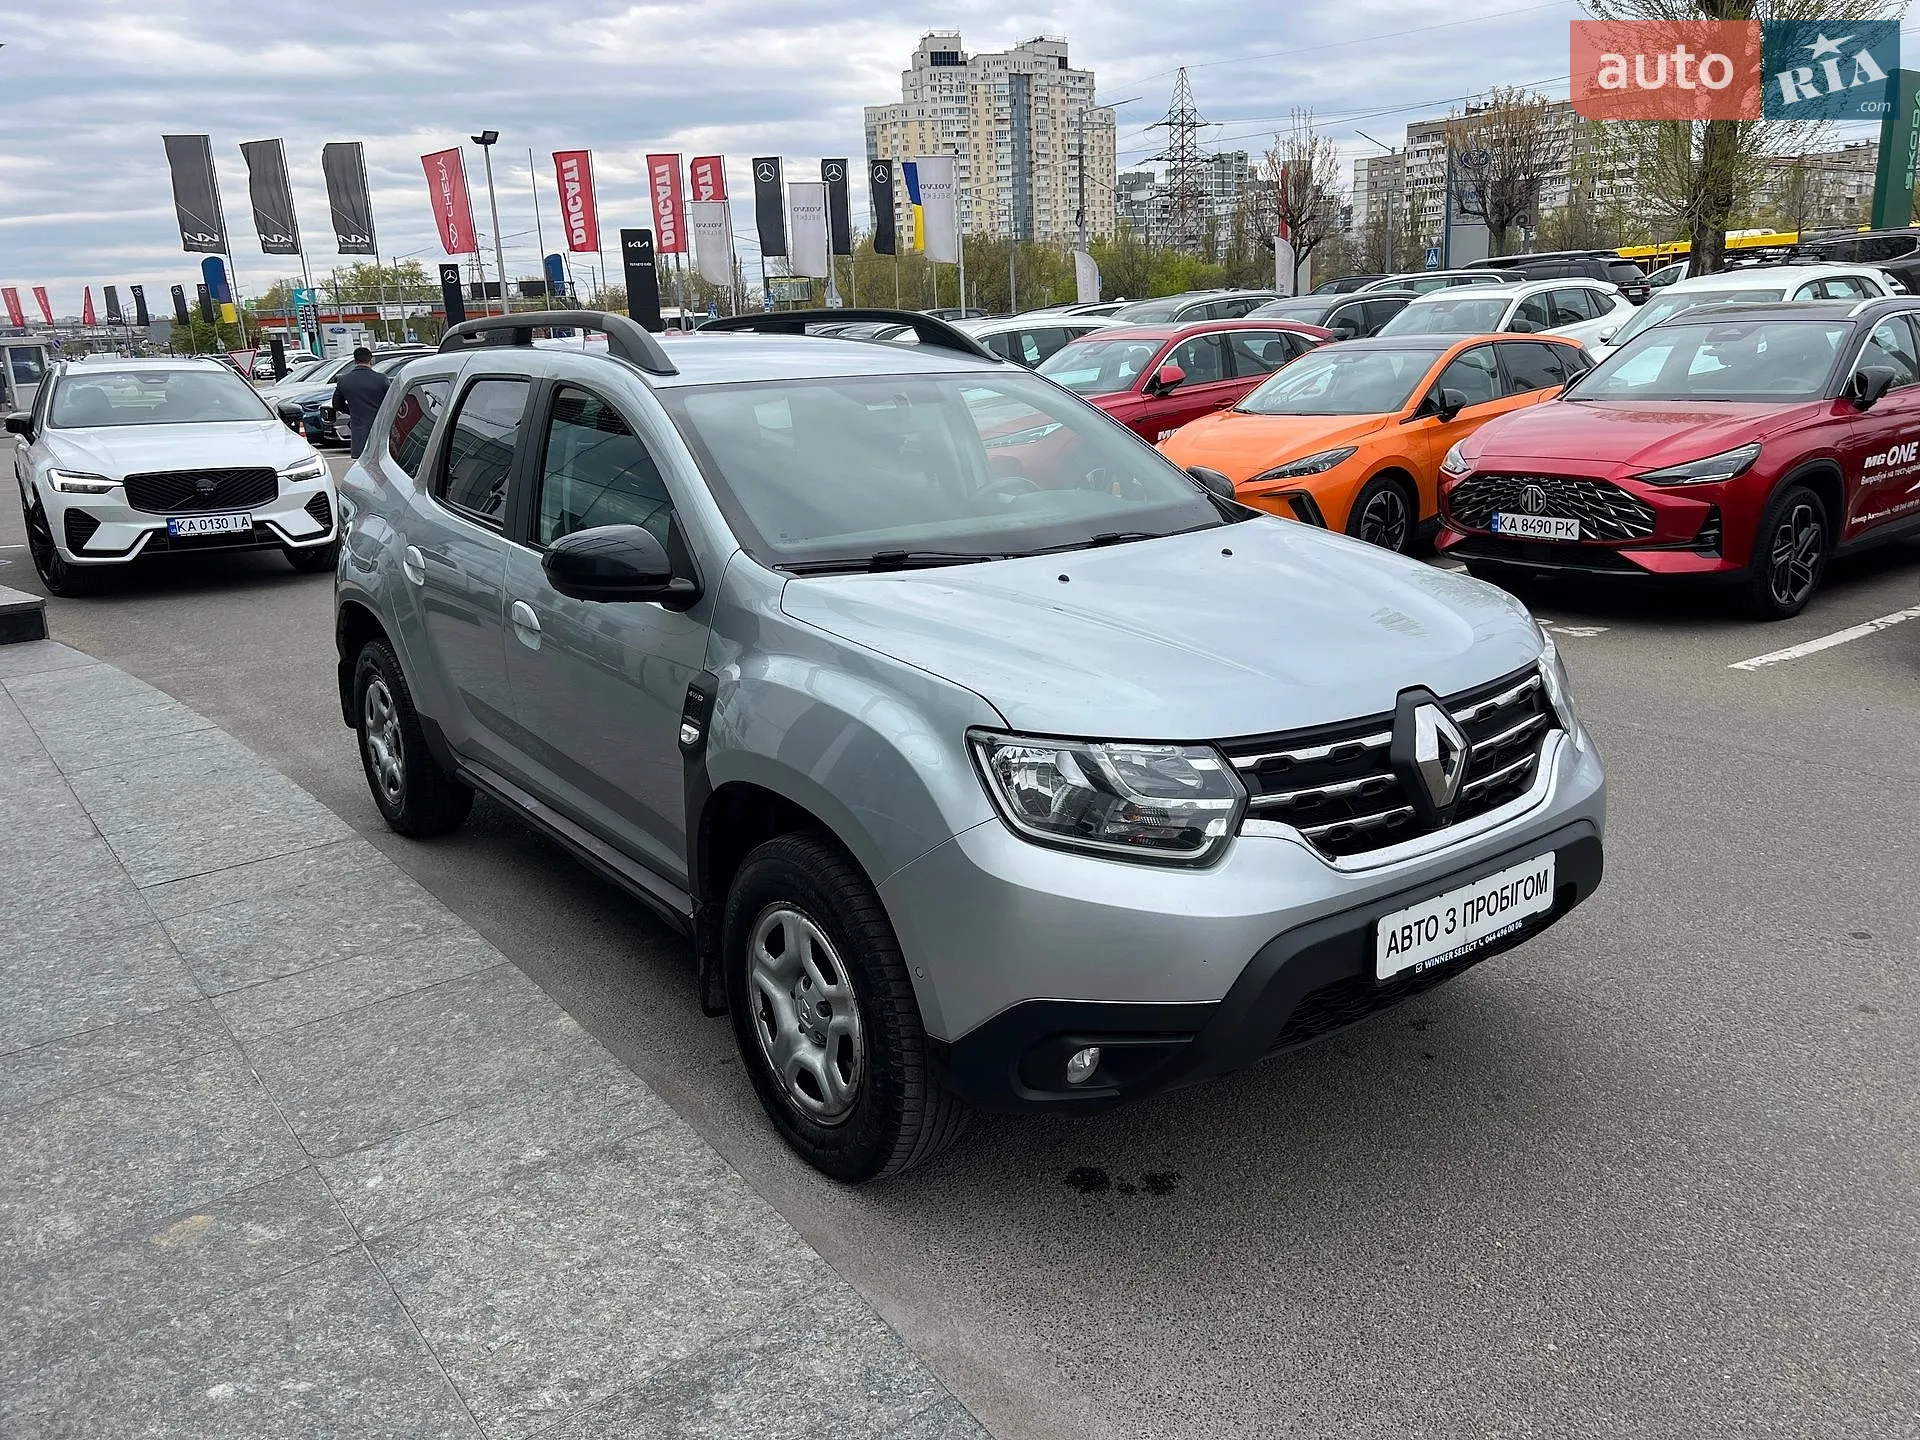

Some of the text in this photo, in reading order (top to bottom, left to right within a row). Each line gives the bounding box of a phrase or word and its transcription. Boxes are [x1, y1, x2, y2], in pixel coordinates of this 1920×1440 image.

[627, 240, 649, 248] KIA
[1864, 441, 1919, 469] MG ONE
[1521, 487, 1544, 512] MG
[176, 520, 197, 532] KA
[199, 518, 229, 530] 0130
[1499, 515, 1576, 536] KA 8490 PK
[1385, 914, 1439, 959] АВТО
[1462, 868, 1549, 928] ПРОБІГОМ
[1424, 951, 1454, 969] WINNER
[1453, 940, 1478, 958] SELECT
